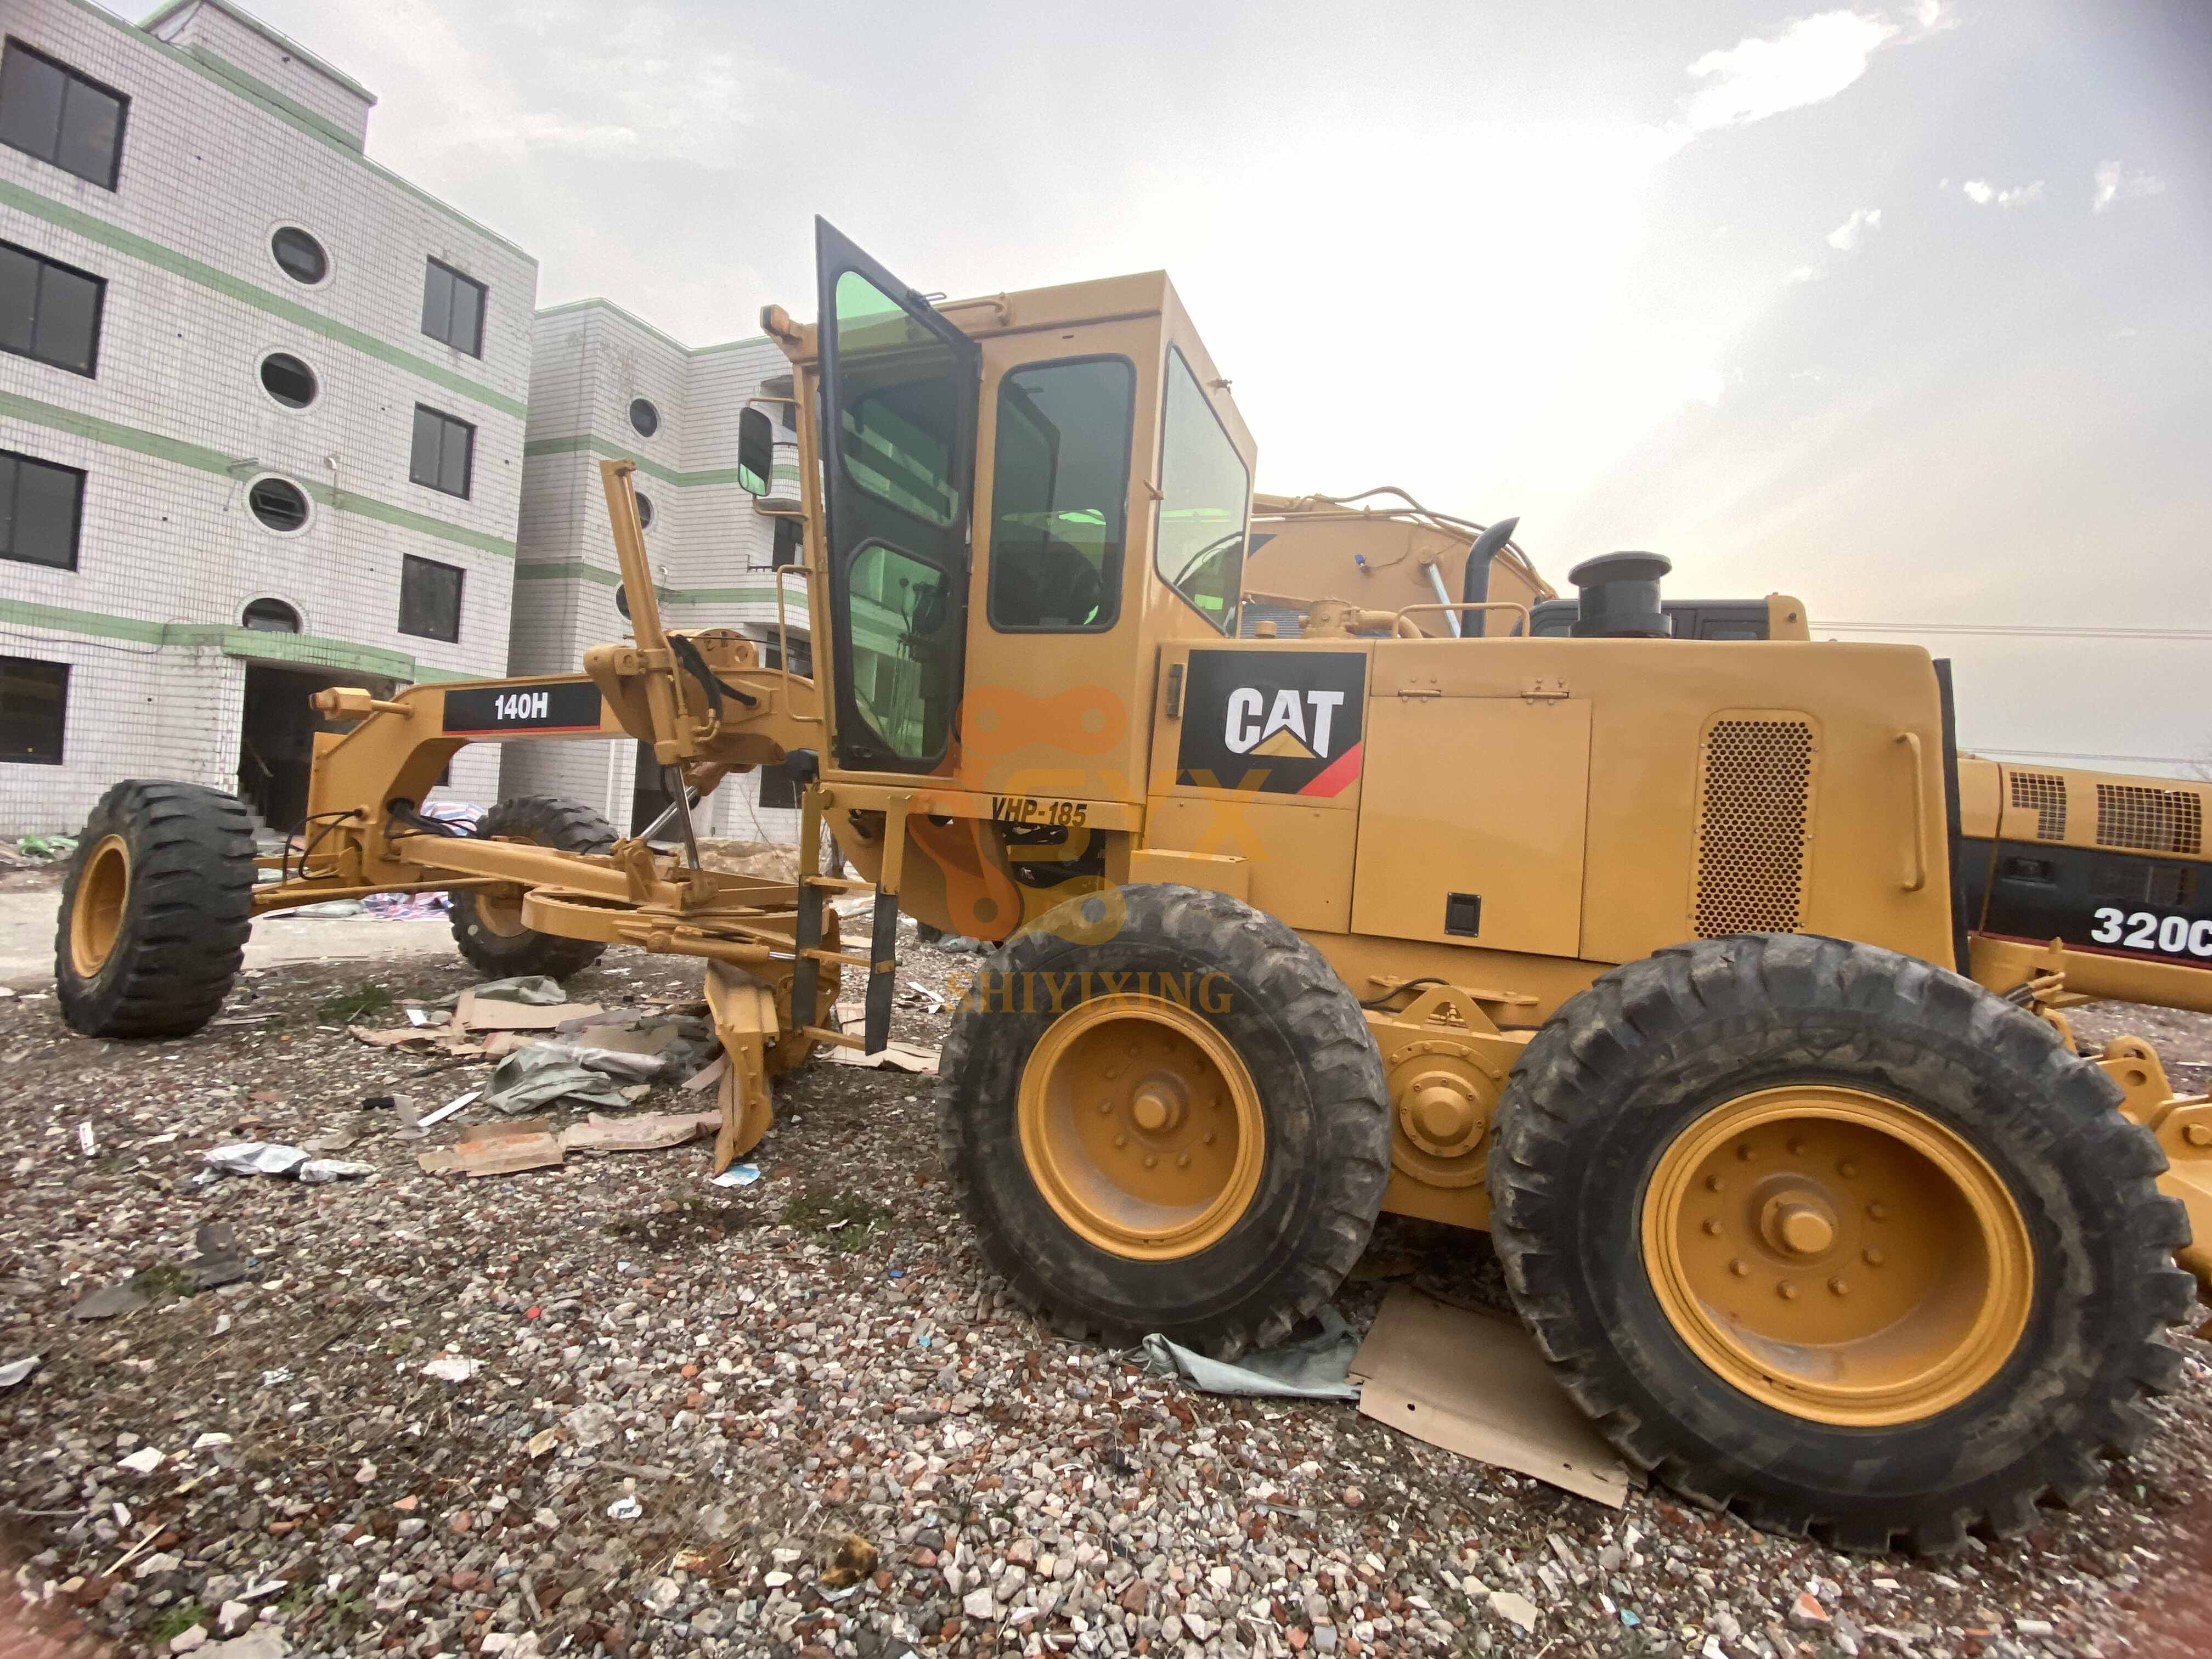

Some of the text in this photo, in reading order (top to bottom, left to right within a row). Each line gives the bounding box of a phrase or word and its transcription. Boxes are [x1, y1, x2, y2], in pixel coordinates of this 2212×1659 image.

[495, 692, 548, 720] 140H
[1225, 688, 1344, 758] CAT
[992, 797, 1088, 828] VHP-185
[2091, 908, 2212, 956] 320C
